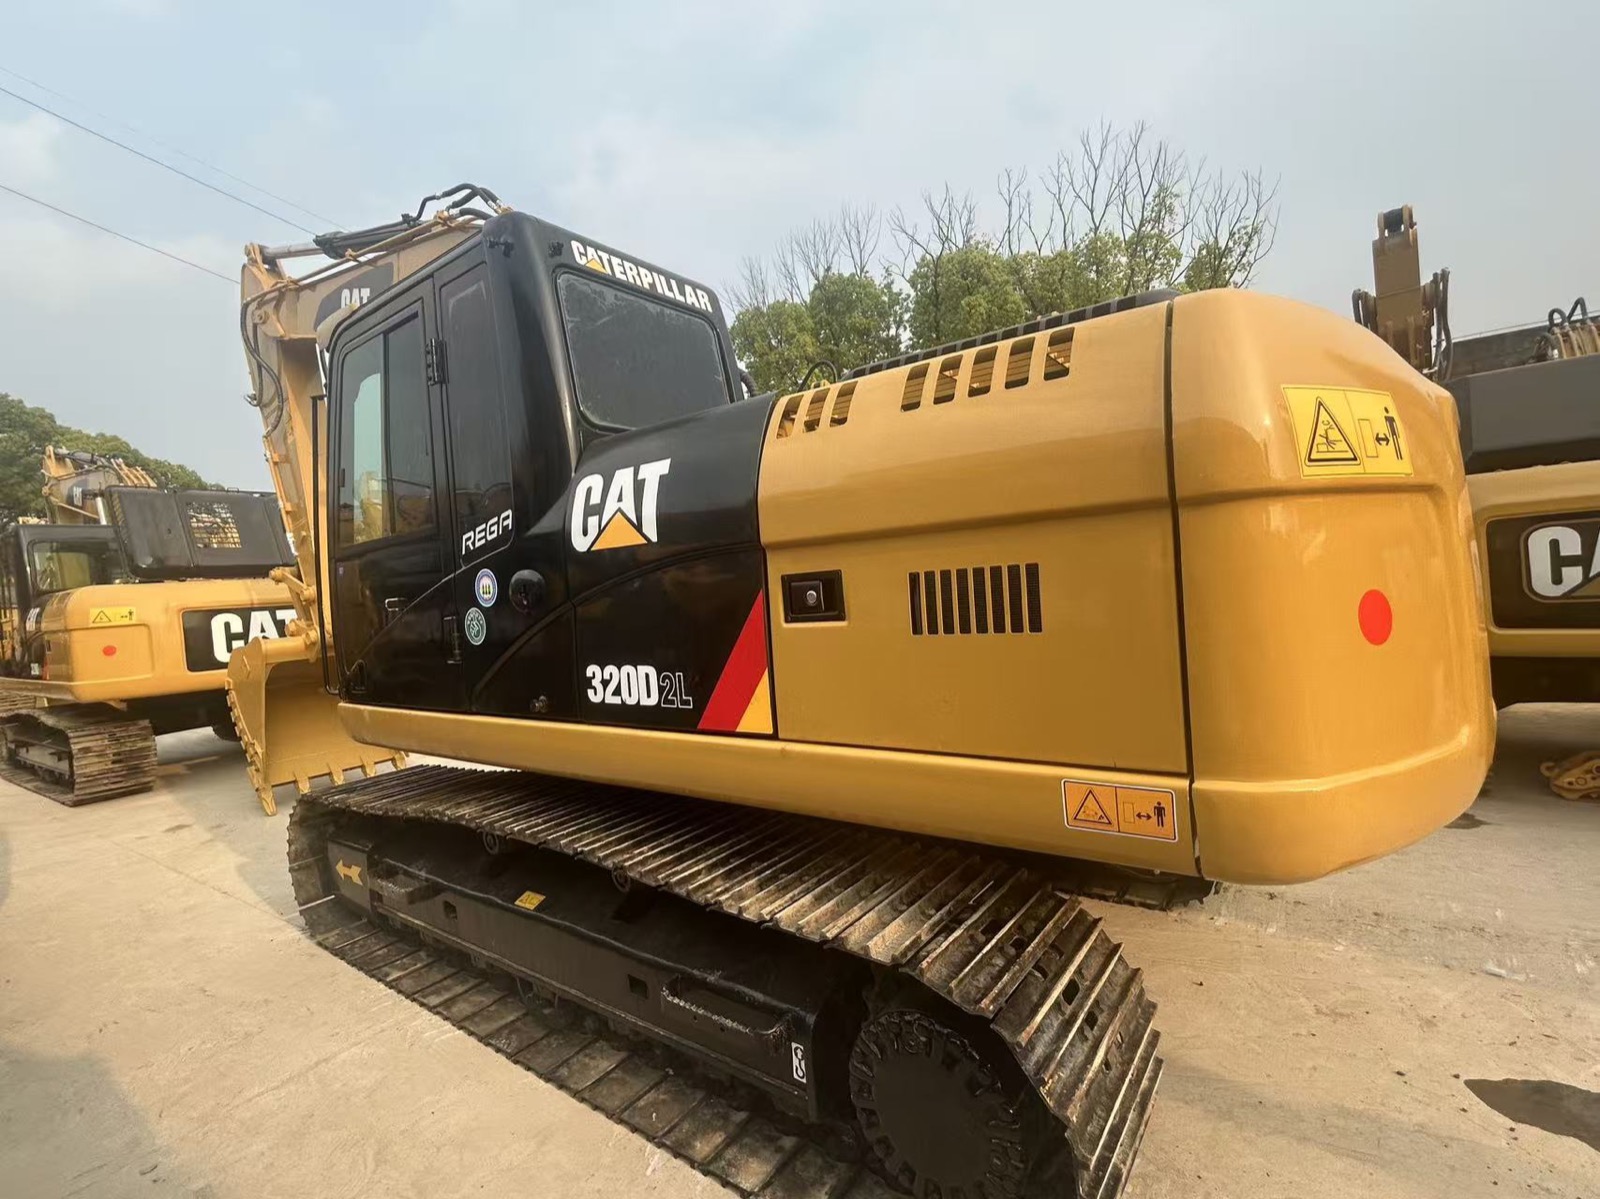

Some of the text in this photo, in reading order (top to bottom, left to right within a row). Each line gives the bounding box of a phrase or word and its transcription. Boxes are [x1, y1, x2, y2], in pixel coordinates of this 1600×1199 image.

[570, 239, 713, 313] CATERPILLAR
[461, 508, 513, 556] REGA
[571, 457, 672, 553] CAT
